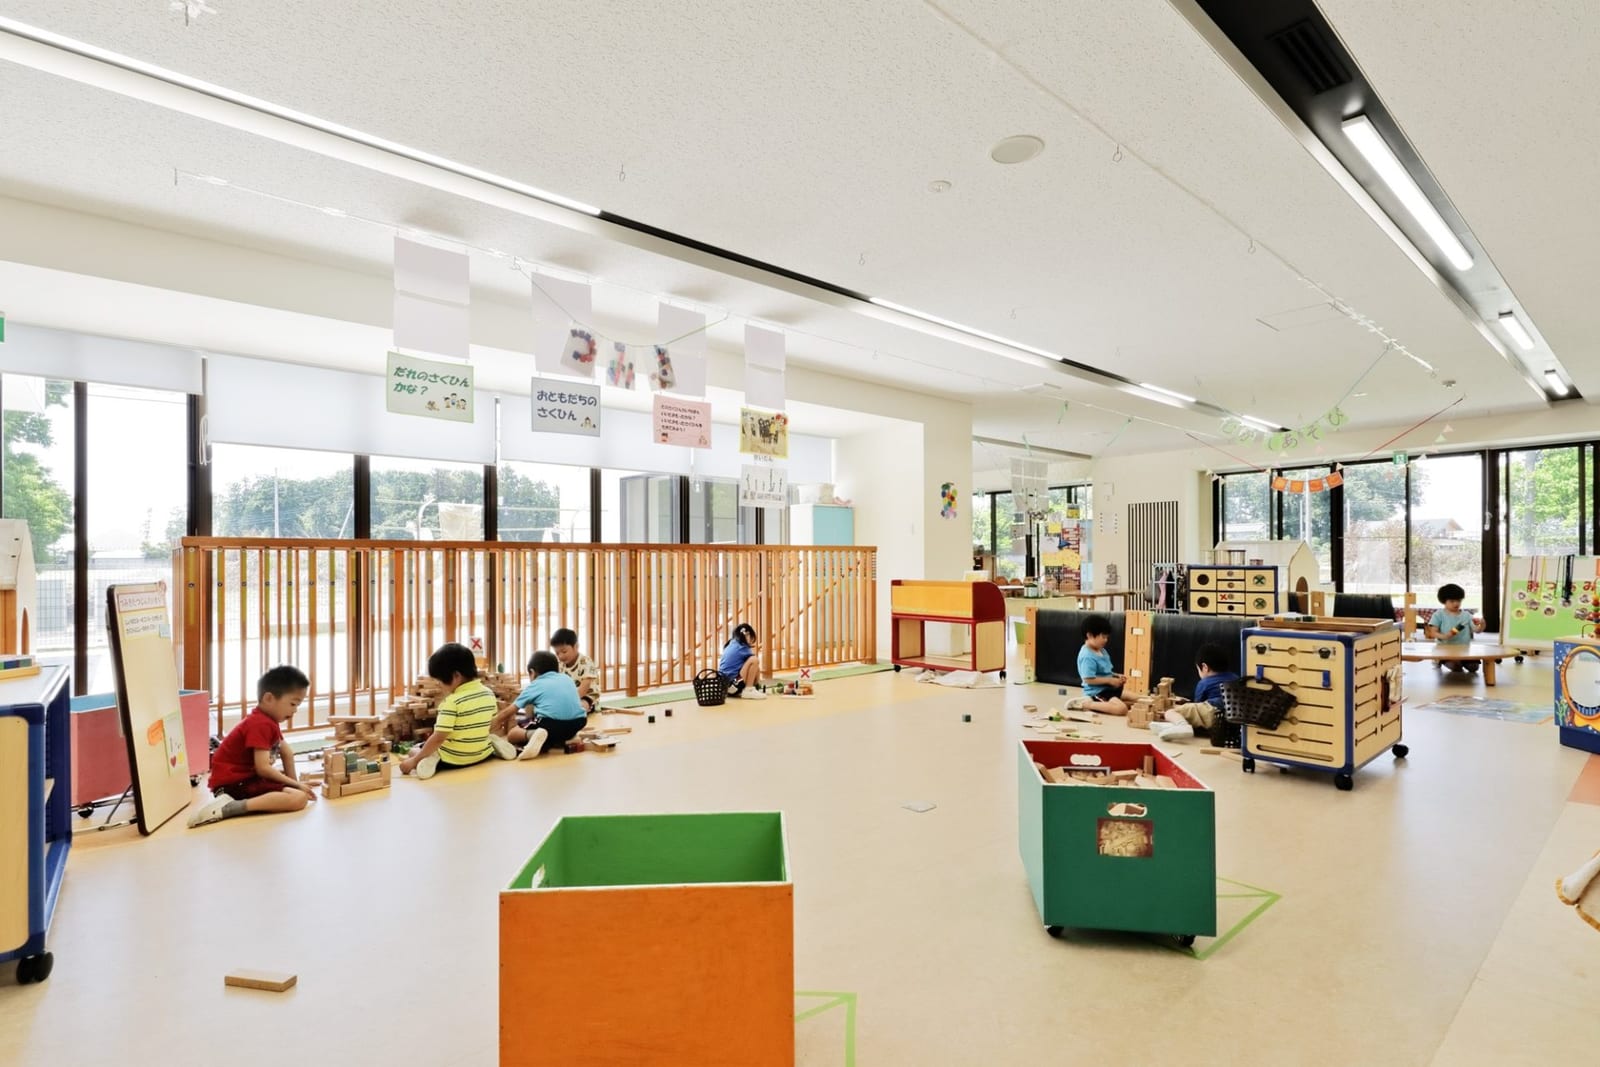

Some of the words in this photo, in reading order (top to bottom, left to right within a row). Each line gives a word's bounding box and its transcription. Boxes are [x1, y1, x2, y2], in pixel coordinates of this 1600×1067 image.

[393, 366, 470, 388] だれのさくひん
[393, 382, 429, 395] かな？
[537, 390, 598, 407] おともだちの
[537, 407, 577, 421] さくひん
